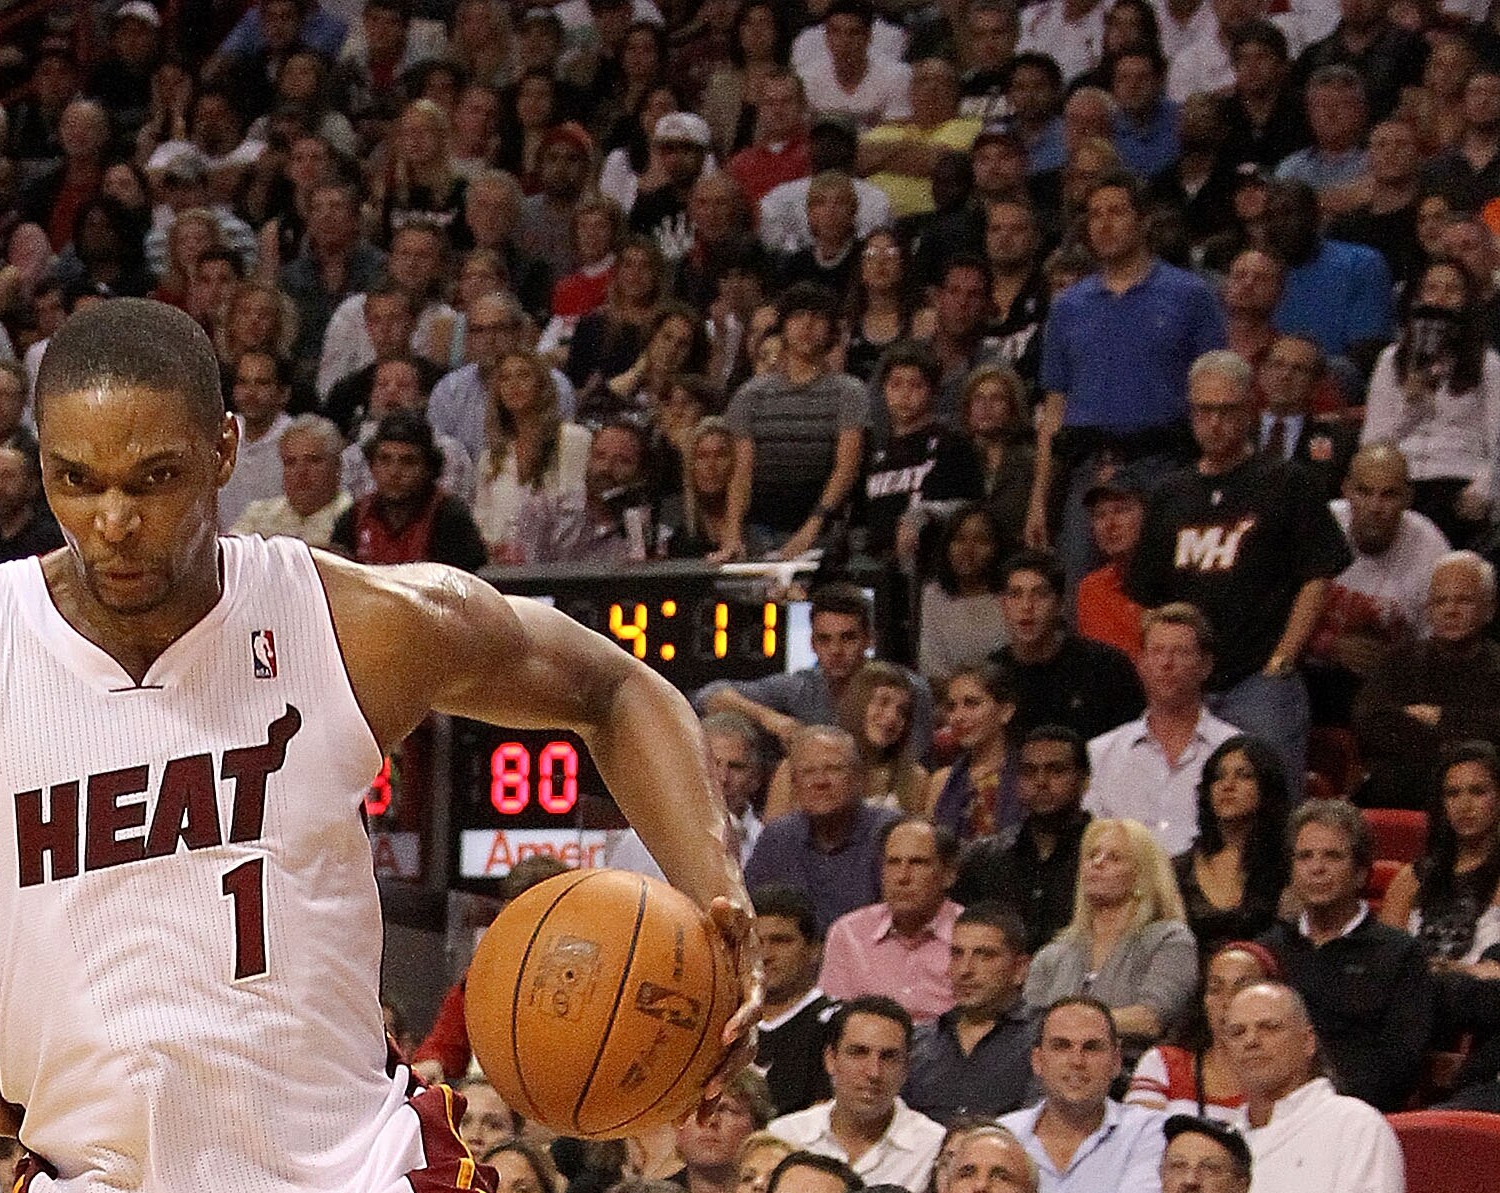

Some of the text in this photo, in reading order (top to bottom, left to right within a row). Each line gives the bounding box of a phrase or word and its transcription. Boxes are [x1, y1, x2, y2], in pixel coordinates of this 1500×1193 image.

[609, 599, 777, 661] 4:11
[14, 702, 303, 888] HEAT
[490, 741, 578, 814] 80
[221, 855, 269, 983] 1
